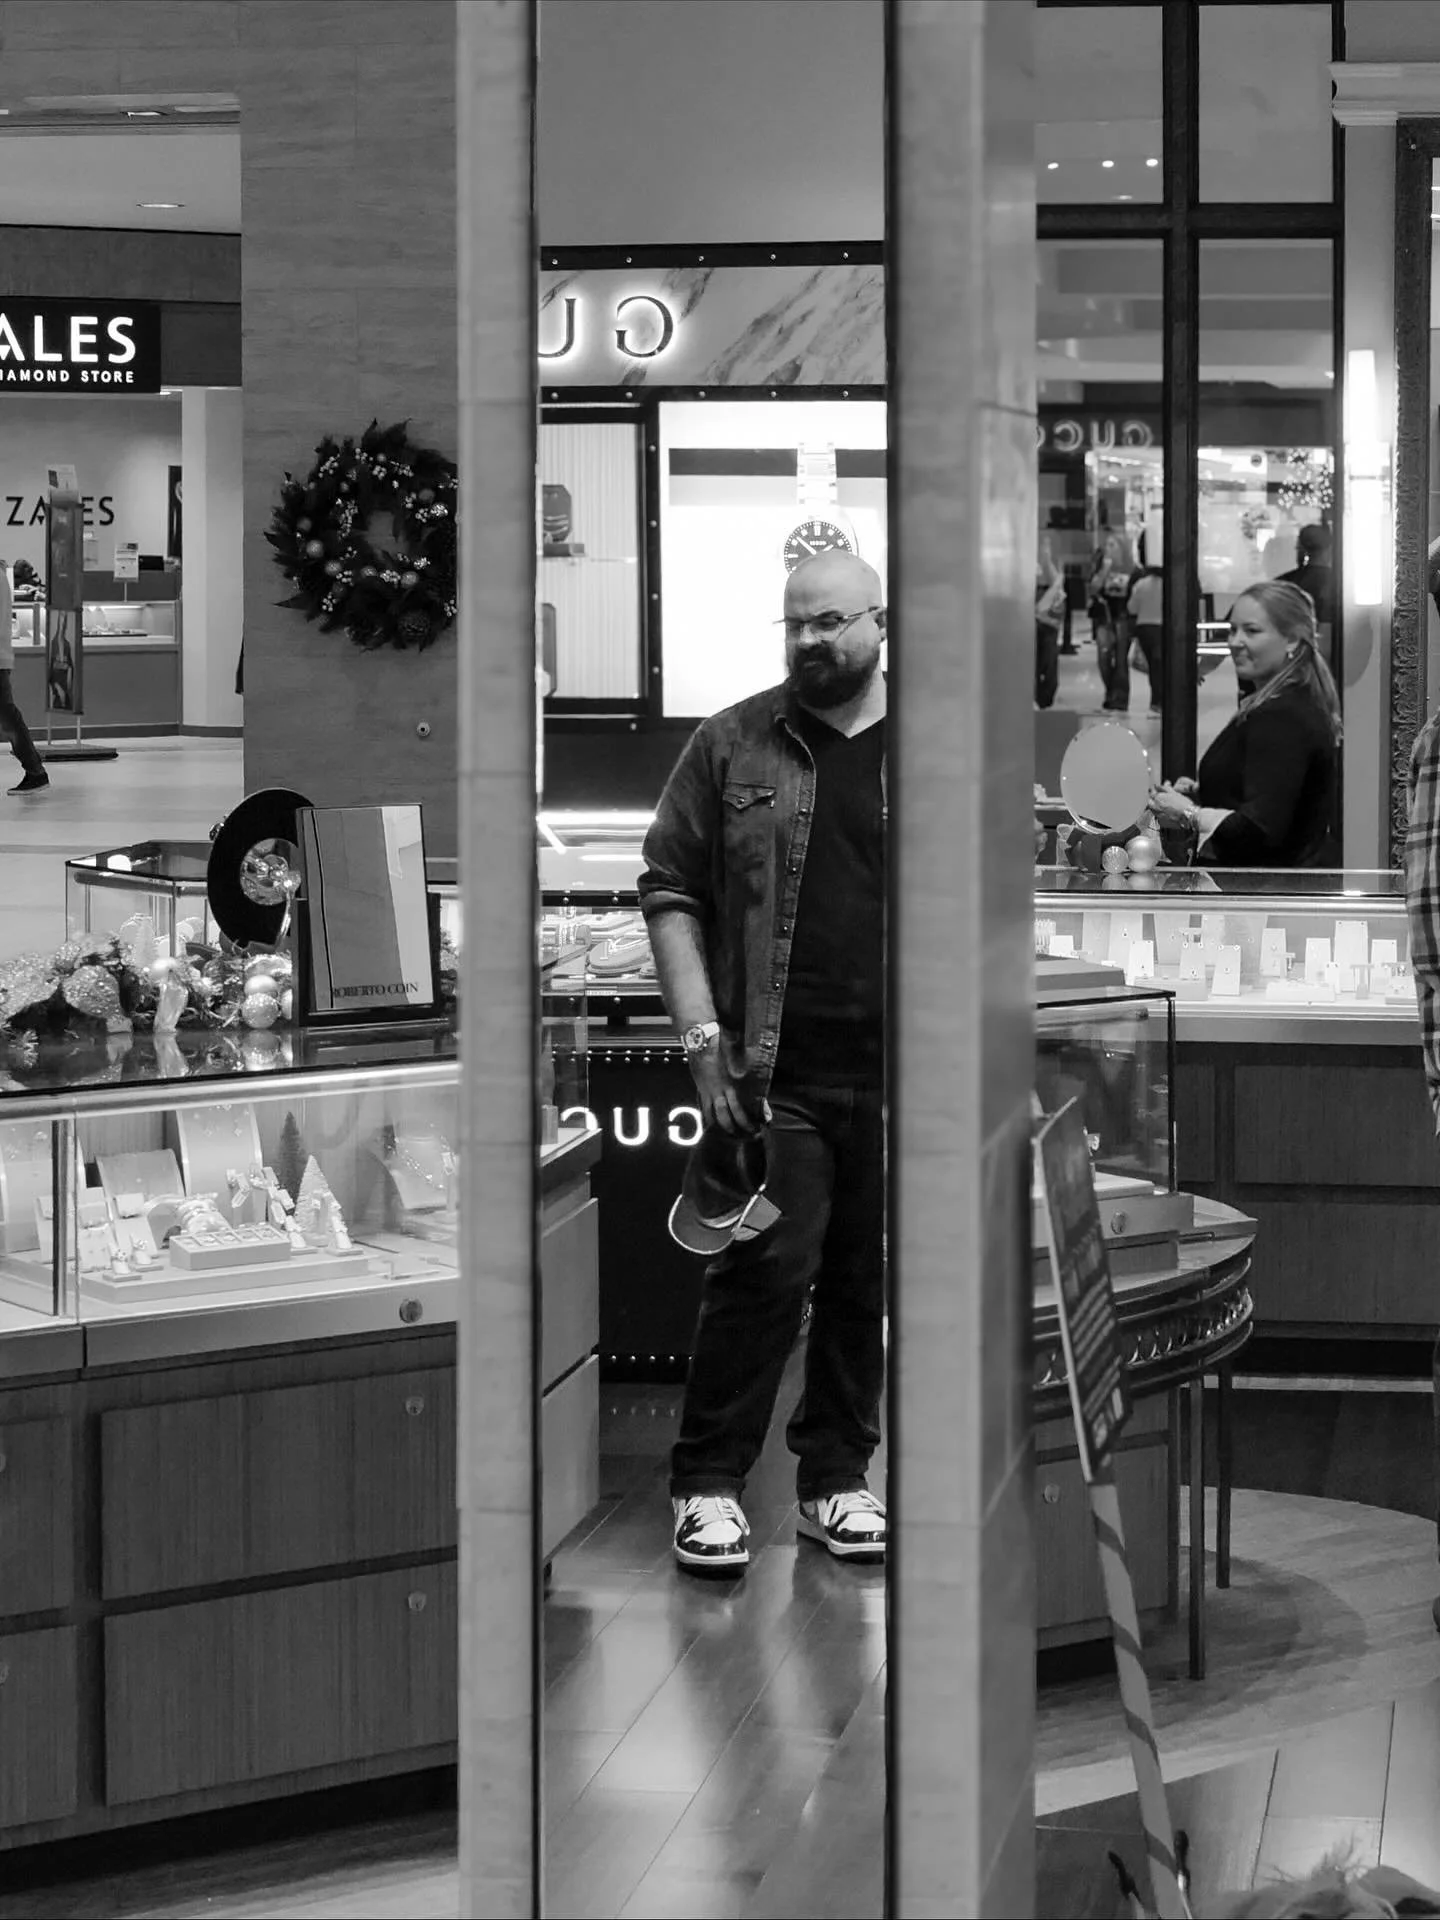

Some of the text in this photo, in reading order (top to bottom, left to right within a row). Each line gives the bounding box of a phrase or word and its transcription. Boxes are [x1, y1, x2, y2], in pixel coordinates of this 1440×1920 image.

[80, 370, 135, 383] STORE
[5, 495, 115, 526] ZAES
[387, 983, 418, 994] COIN
